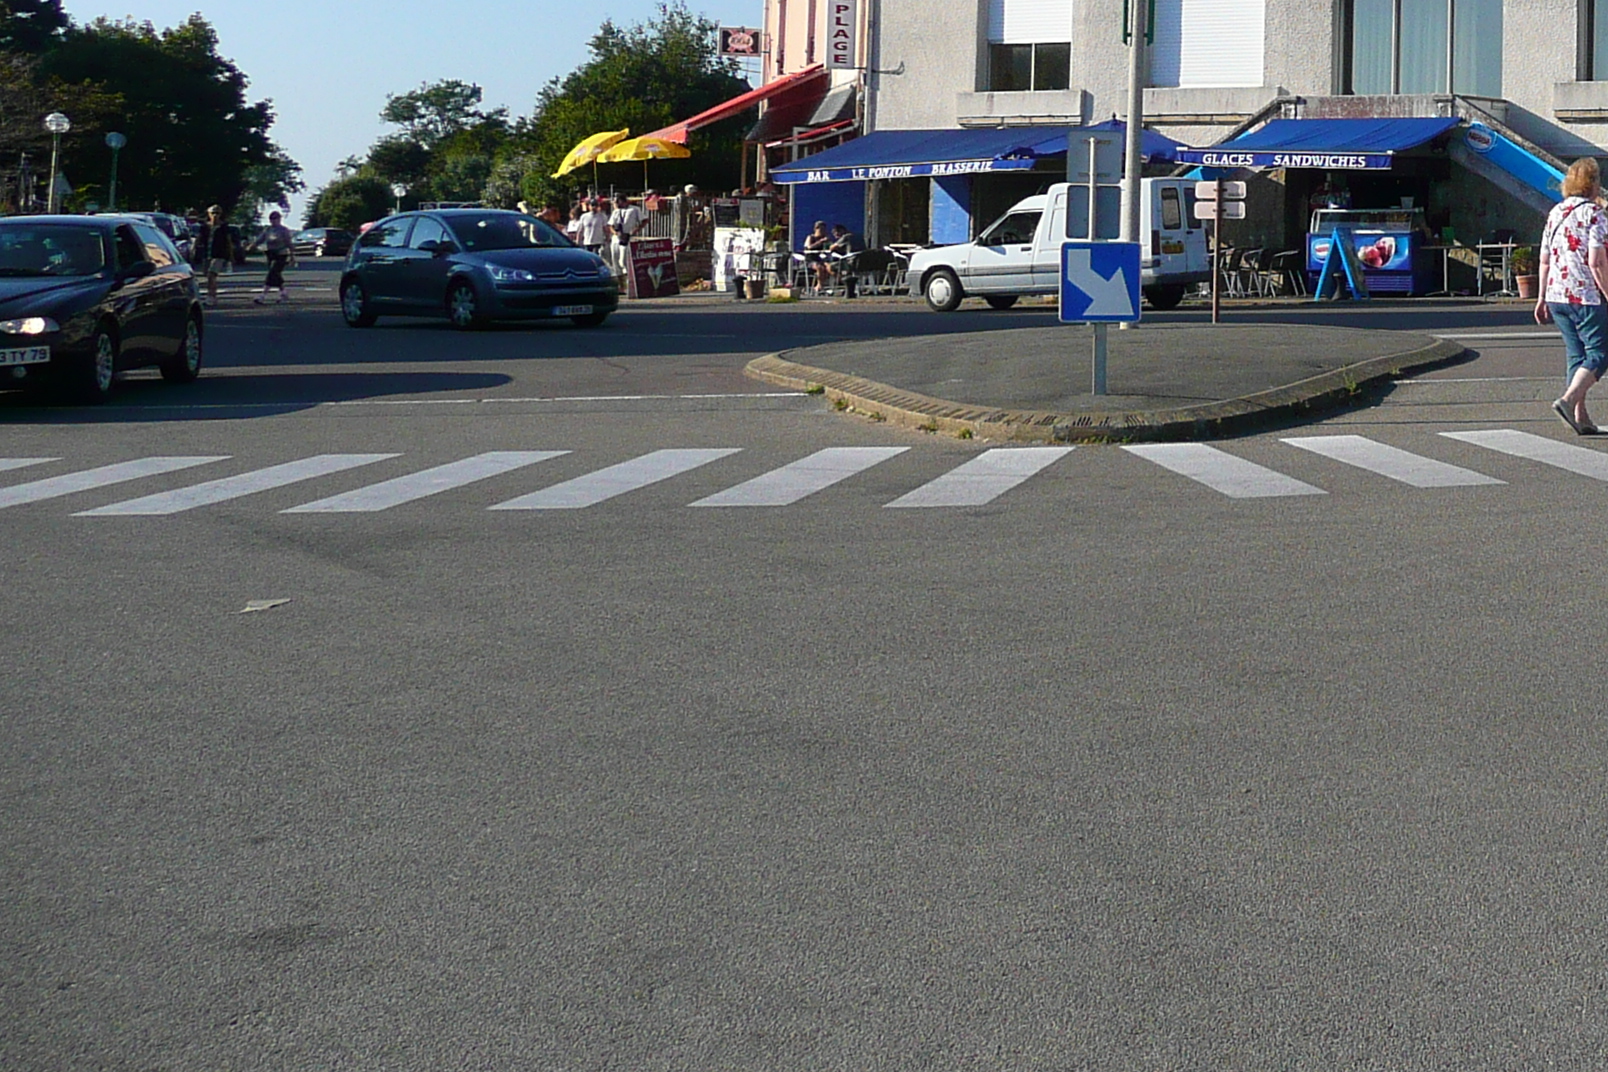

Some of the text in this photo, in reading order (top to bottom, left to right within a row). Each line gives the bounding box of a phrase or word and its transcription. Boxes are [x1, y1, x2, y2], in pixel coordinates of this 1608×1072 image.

[833, 5, 850, 64] PLAGE
[1202, 153, 1366, 167] GLACES SANDWICHES
[807, 161, 994, 182] BAR LE PONTON BRASSERIE
[11, 350, 26, 362] TY
[30, 348, 48, 360] 79
